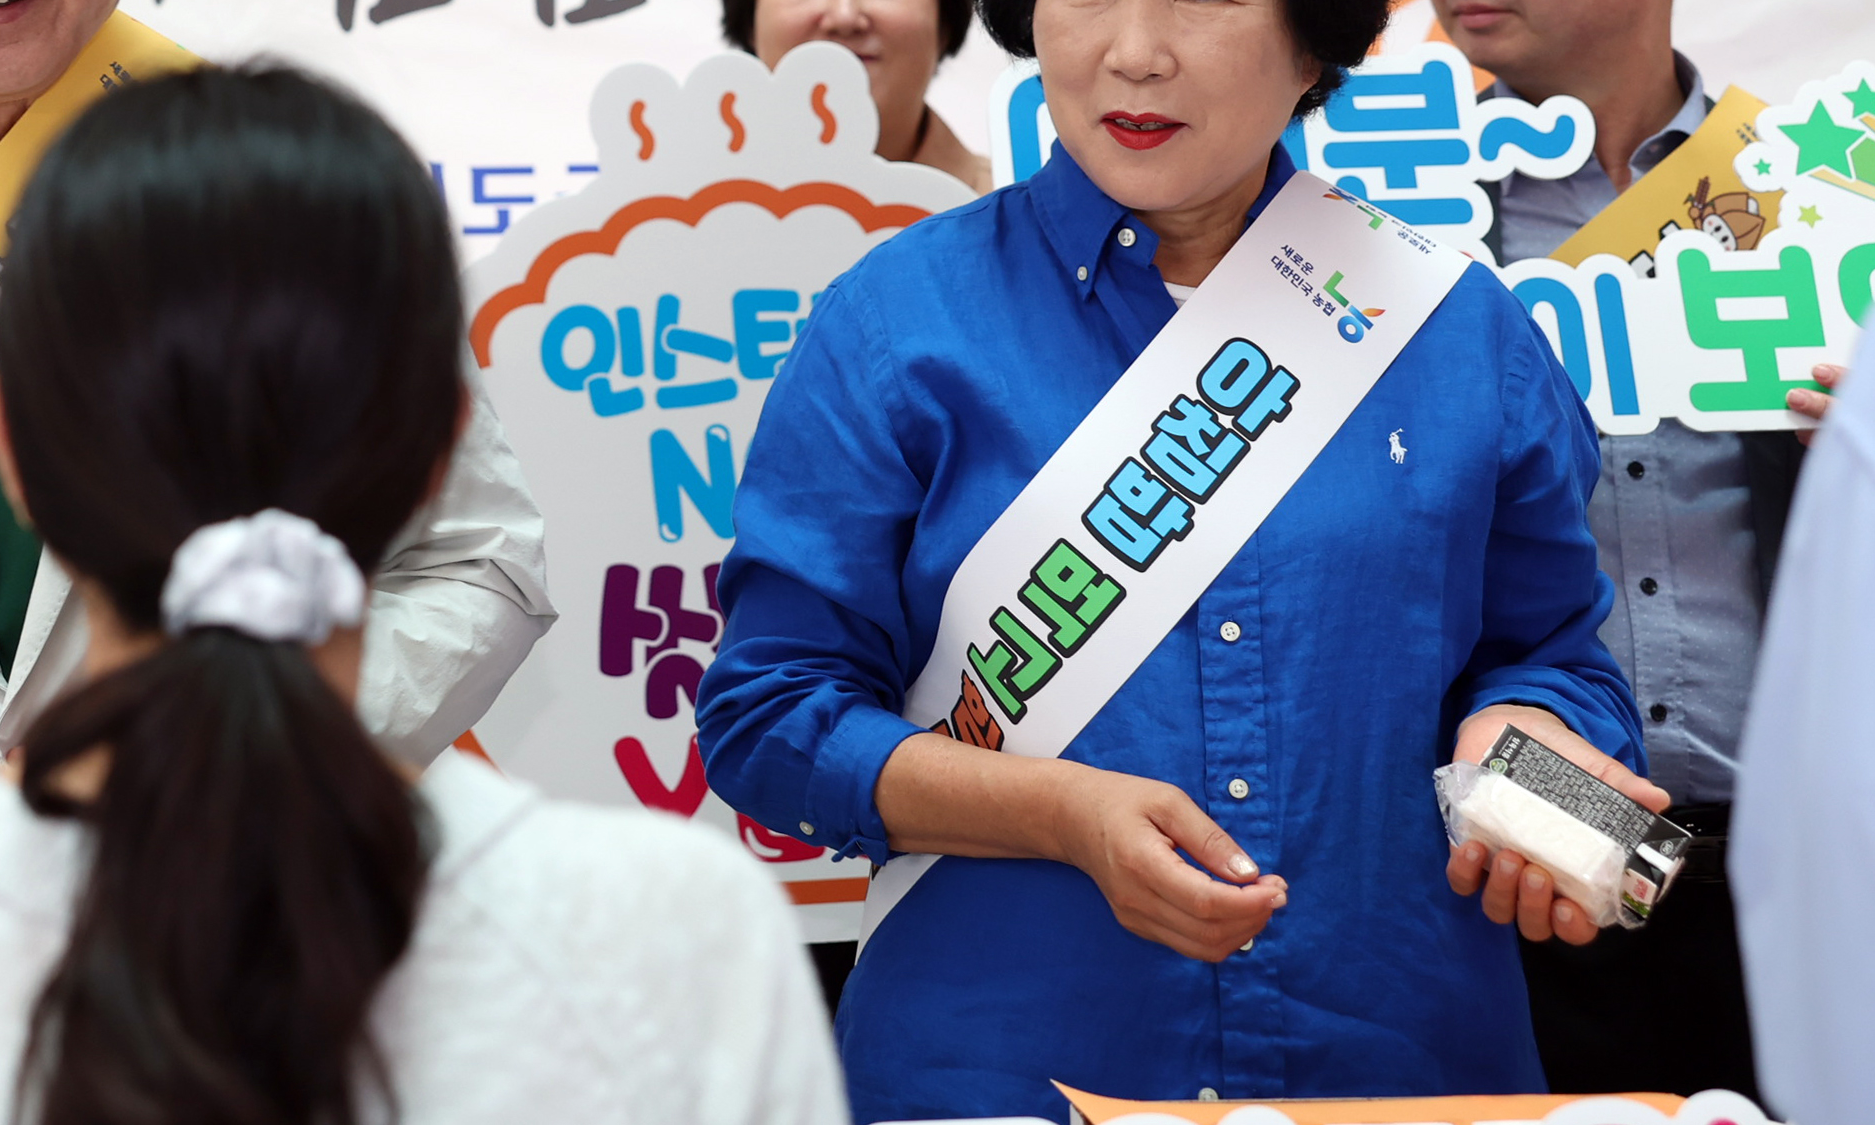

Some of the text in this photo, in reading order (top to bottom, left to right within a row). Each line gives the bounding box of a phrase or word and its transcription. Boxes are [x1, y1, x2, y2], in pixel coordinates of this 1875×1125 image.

[1269, 254, 1337, 318] 대한민국 농협
[1280, 243, 1315, 276] 새로운
[1676, 242, 1875, 413] 보
[649, 423, 747, 543] N
[1081, 337, 1301, 573] 아침밥
[966, 537, 1127, 725] 먹고
